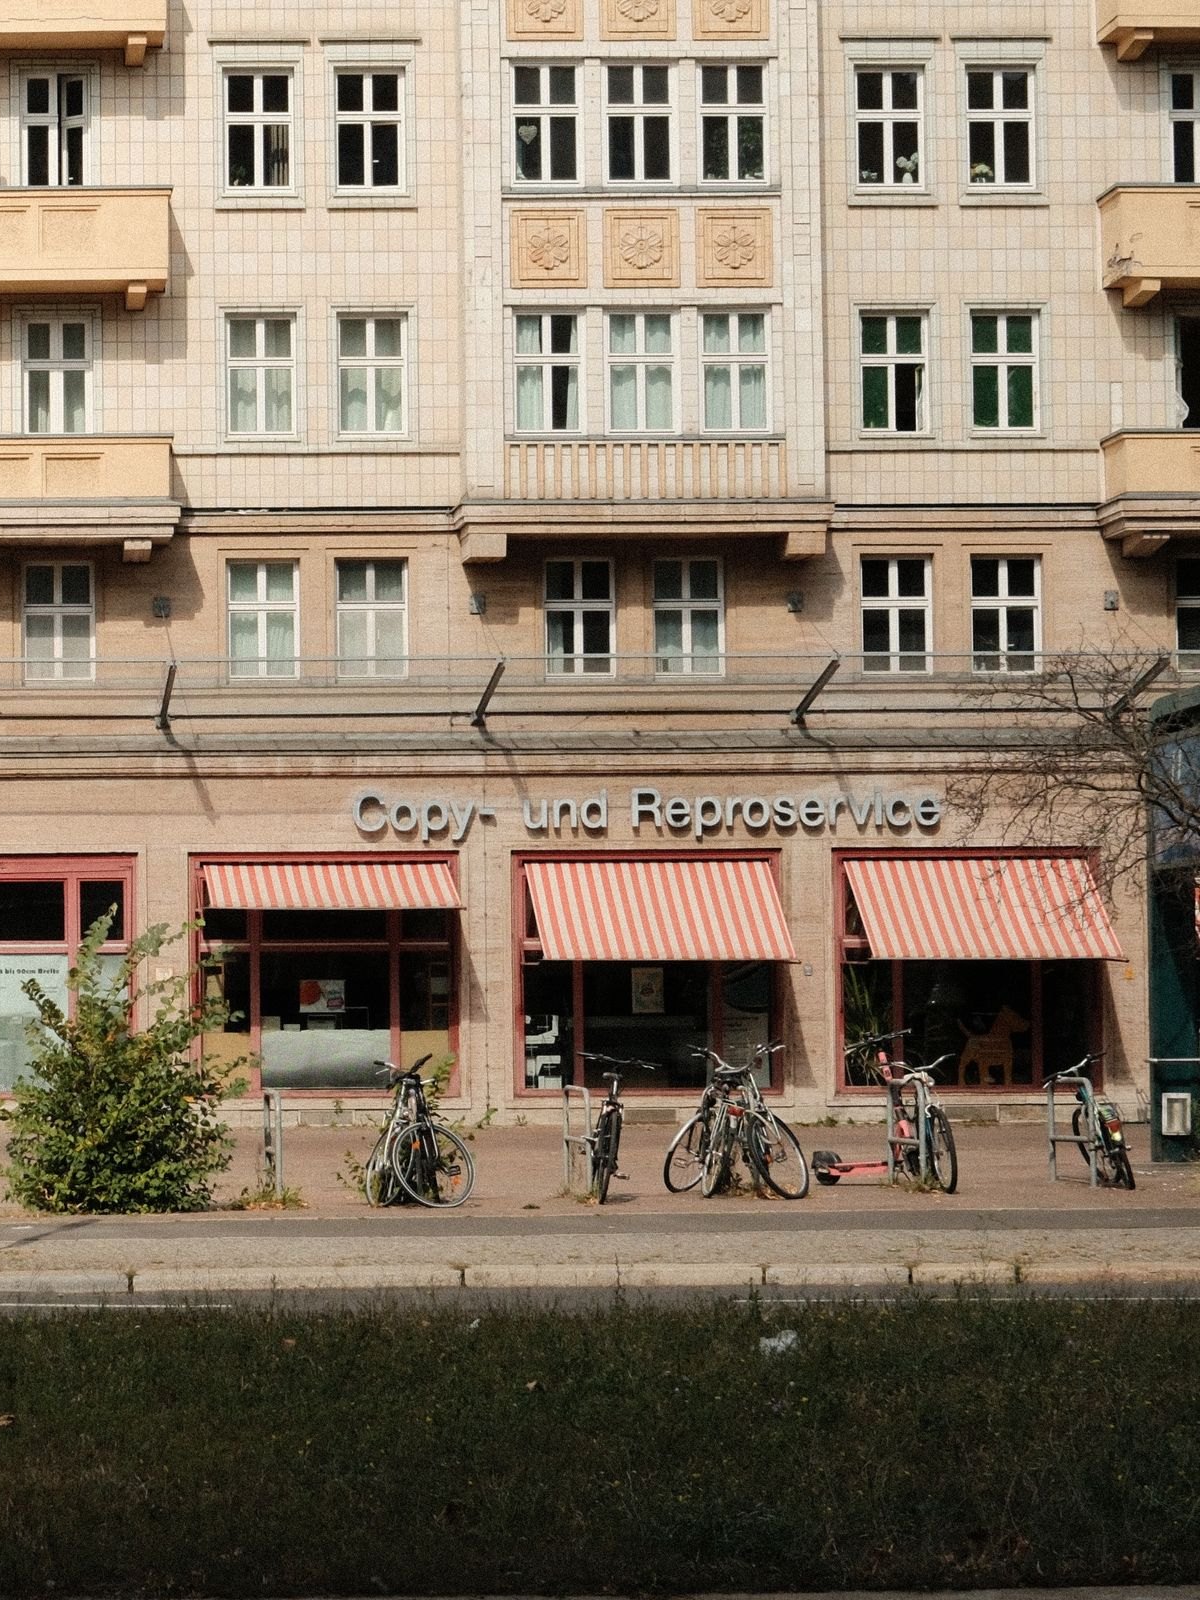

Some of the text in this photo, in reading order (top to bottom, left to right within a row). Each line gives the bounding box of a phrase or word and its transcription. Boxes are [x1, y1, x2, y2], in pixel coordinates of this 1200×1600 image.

[353, 786, 941, 841] Copy- und Reproservice
